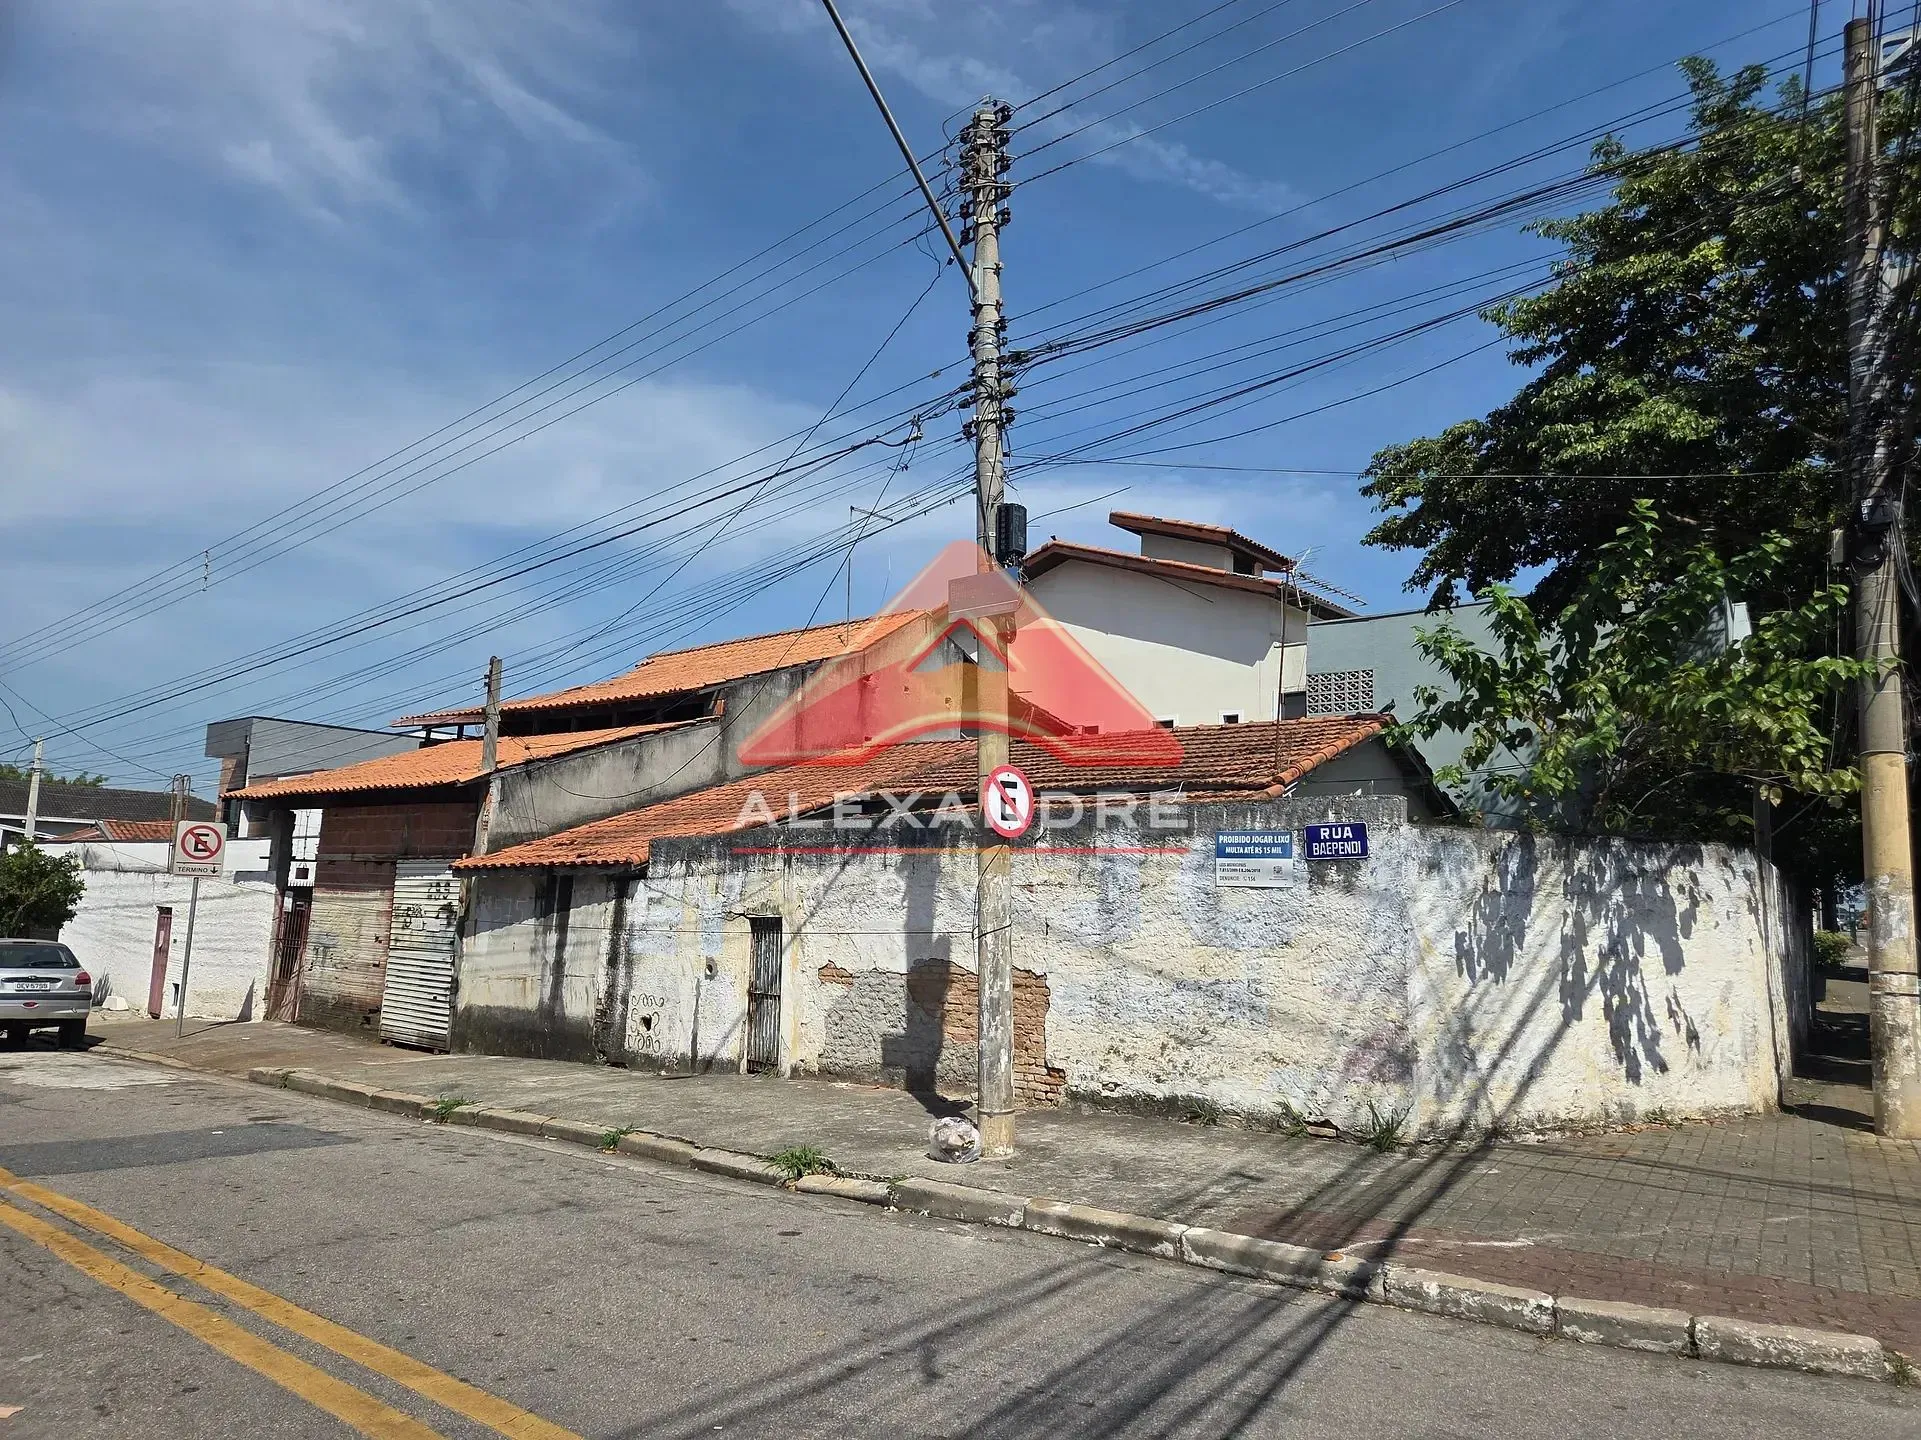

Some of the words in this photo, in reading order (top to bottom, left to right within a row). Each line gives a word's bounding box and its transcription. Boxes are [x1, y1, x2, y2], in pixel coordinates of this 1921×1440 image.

[1320, 826, 1353, 840] RUA
[1218, 835, 1251, 844] PROIBIDO
[1251, 835, 1273, 844] JOGAR
[1274, 835, 1290, 844] LIXO
[1225, 846, 1243, 854] MULTA
[1244, 845, 1254, 854] ATÉ
[1255, 846, 1263, 855] R$
[1263, 846, 1271, 854] 15
[1271, 846, 1283, 854] MIL
[1312, 841, 1362, 856] BAEPENDI
